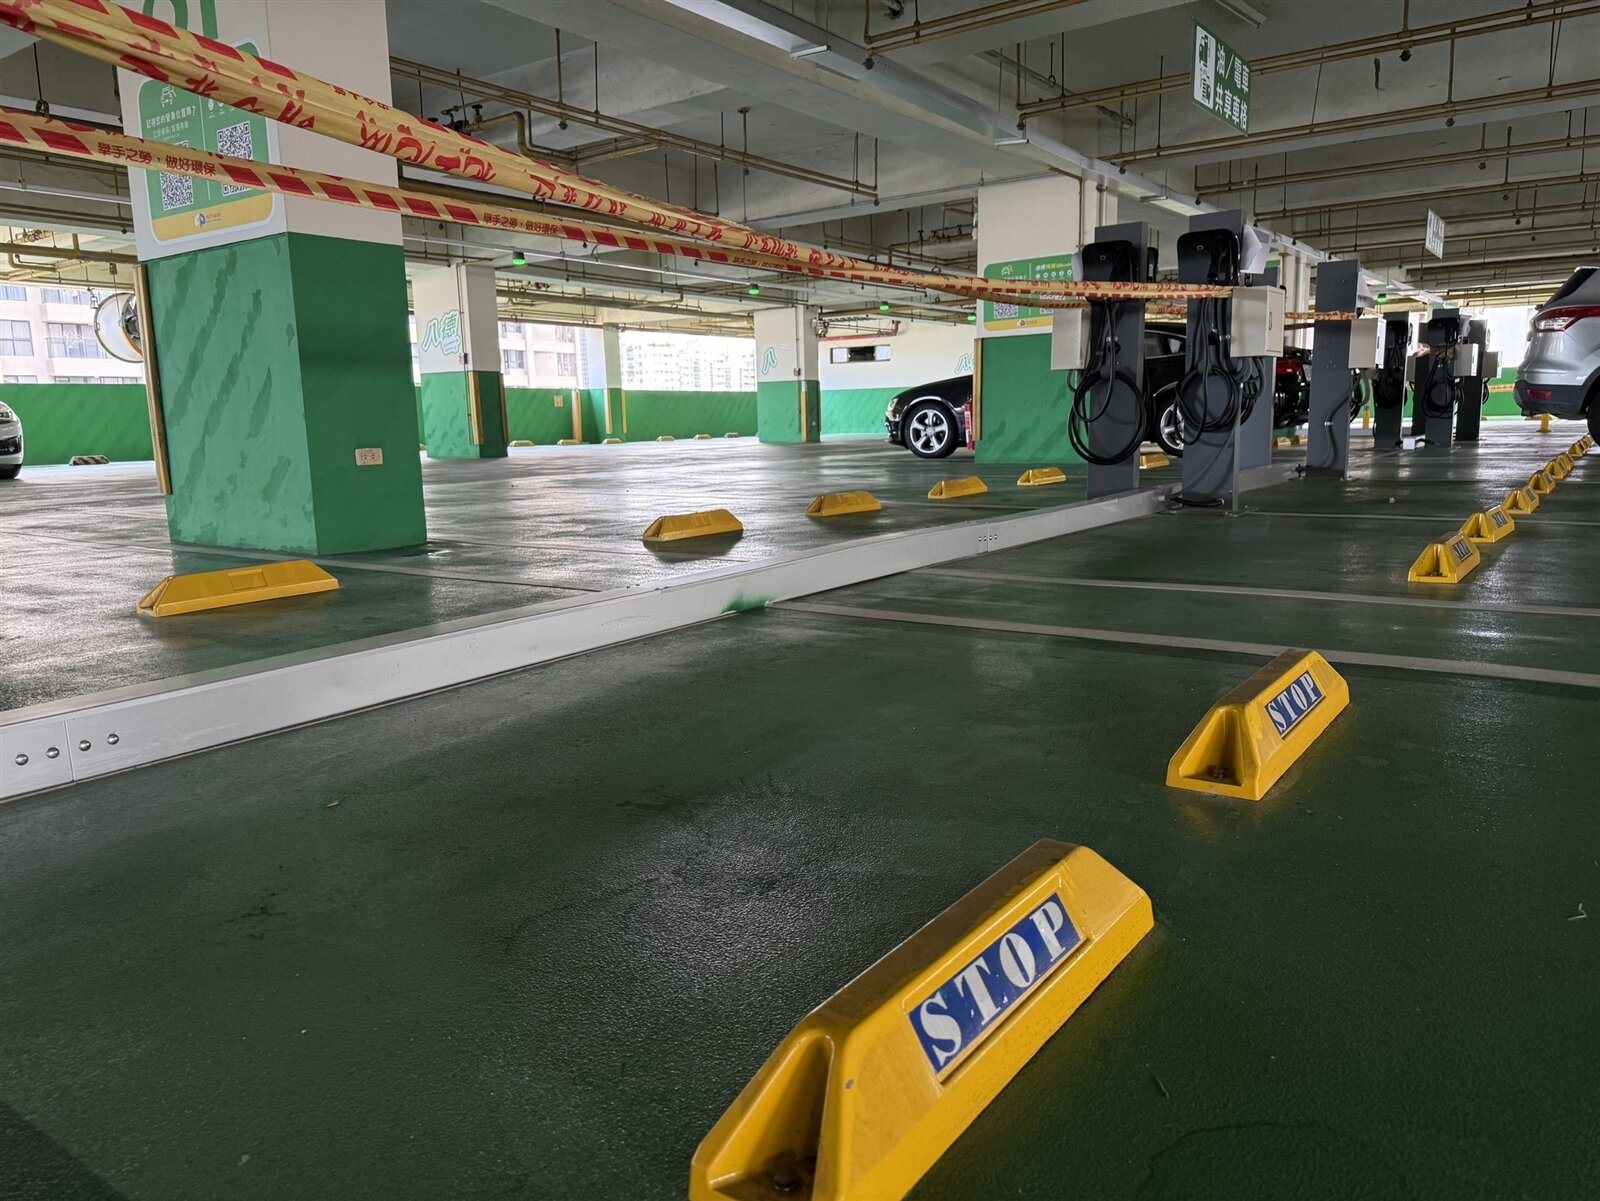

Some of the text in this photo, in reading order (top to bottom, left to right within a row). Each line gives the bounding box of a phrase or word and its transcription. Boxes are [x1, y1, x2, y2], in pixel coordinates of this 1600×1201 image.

[1215, 82, 1248, 130] 共享車格
[1268, 673, 1317, 733] STOP
[920, 901, 1063, 1066] STOP
